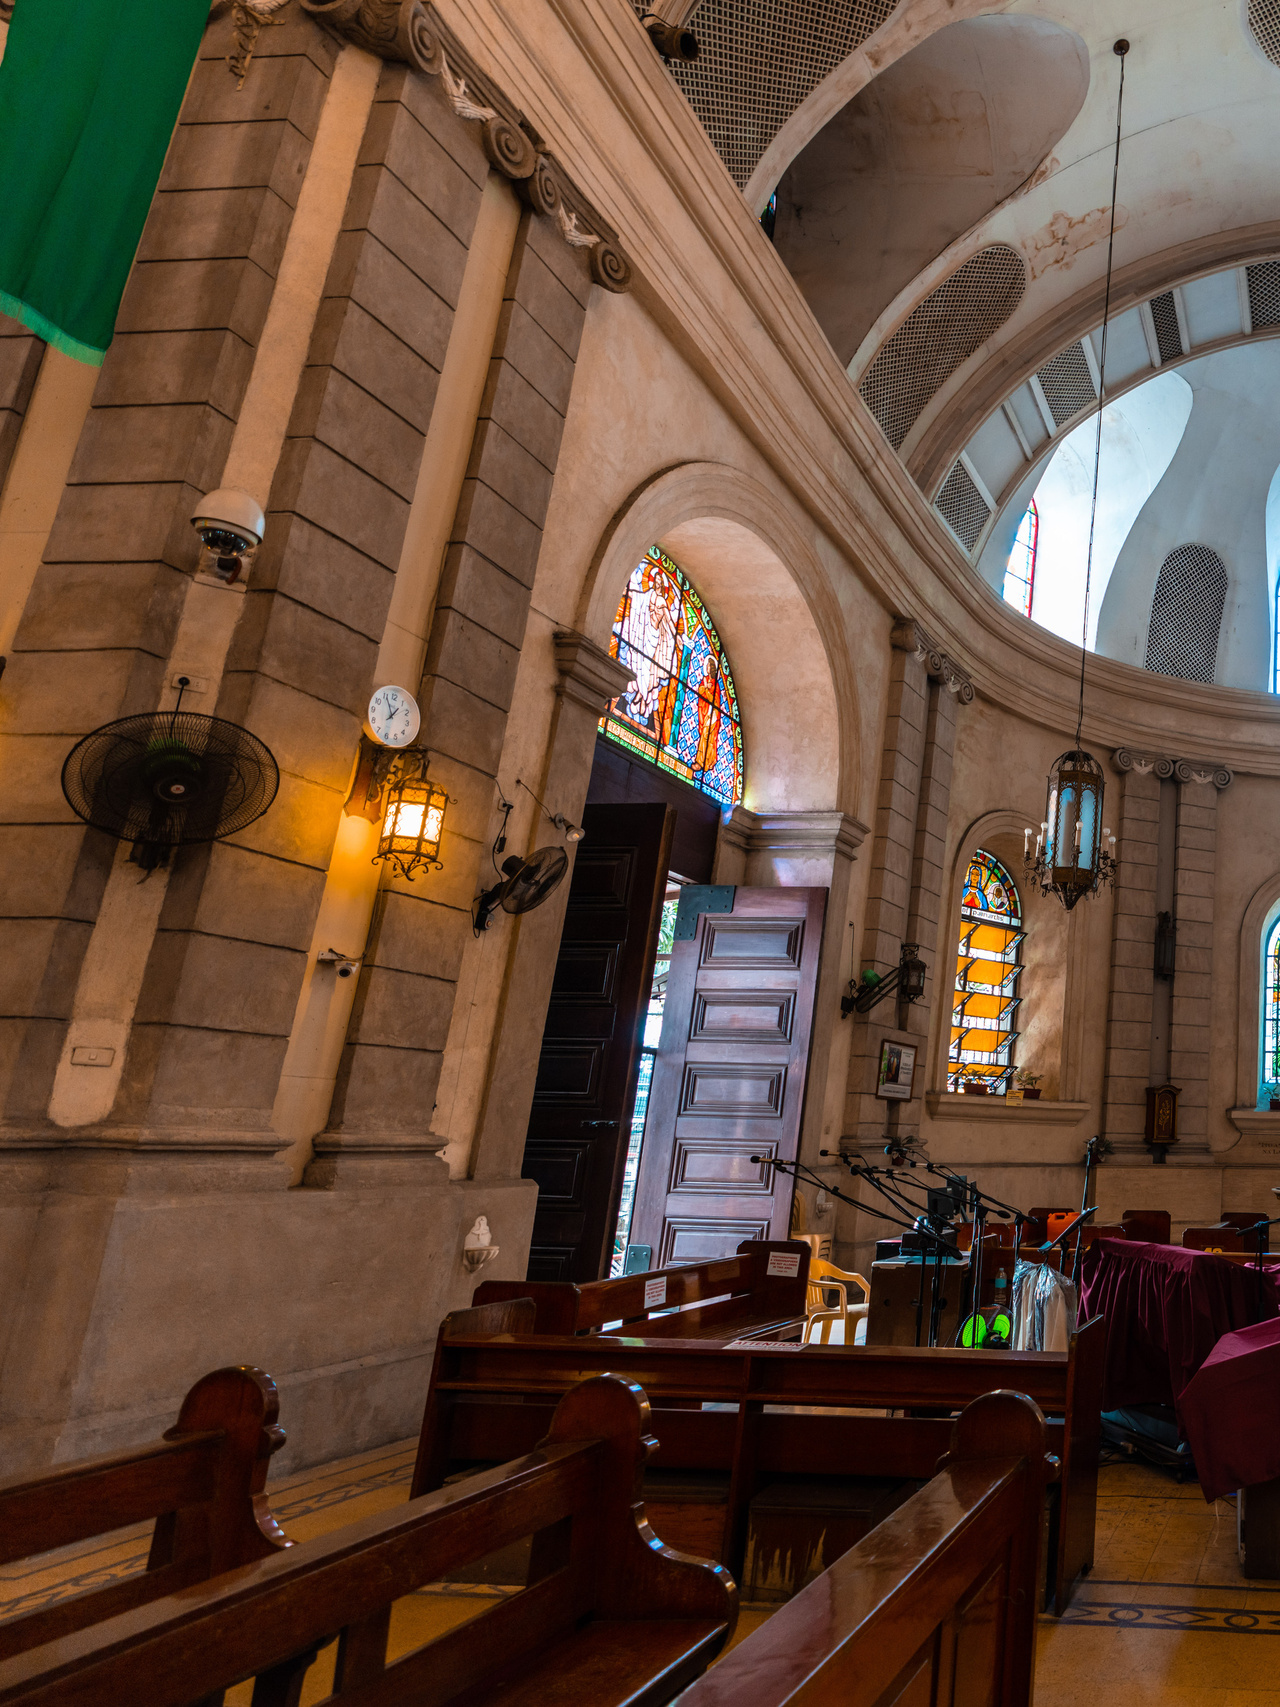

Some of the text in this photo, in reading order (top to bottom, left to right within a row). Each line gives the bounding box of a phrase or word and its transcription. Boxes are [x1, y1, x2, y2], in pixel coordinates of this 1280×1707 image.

[375, 697, 382, 705] 10
[391, 693, 398, 701] 12
[371, 716, 376, 724] 8
